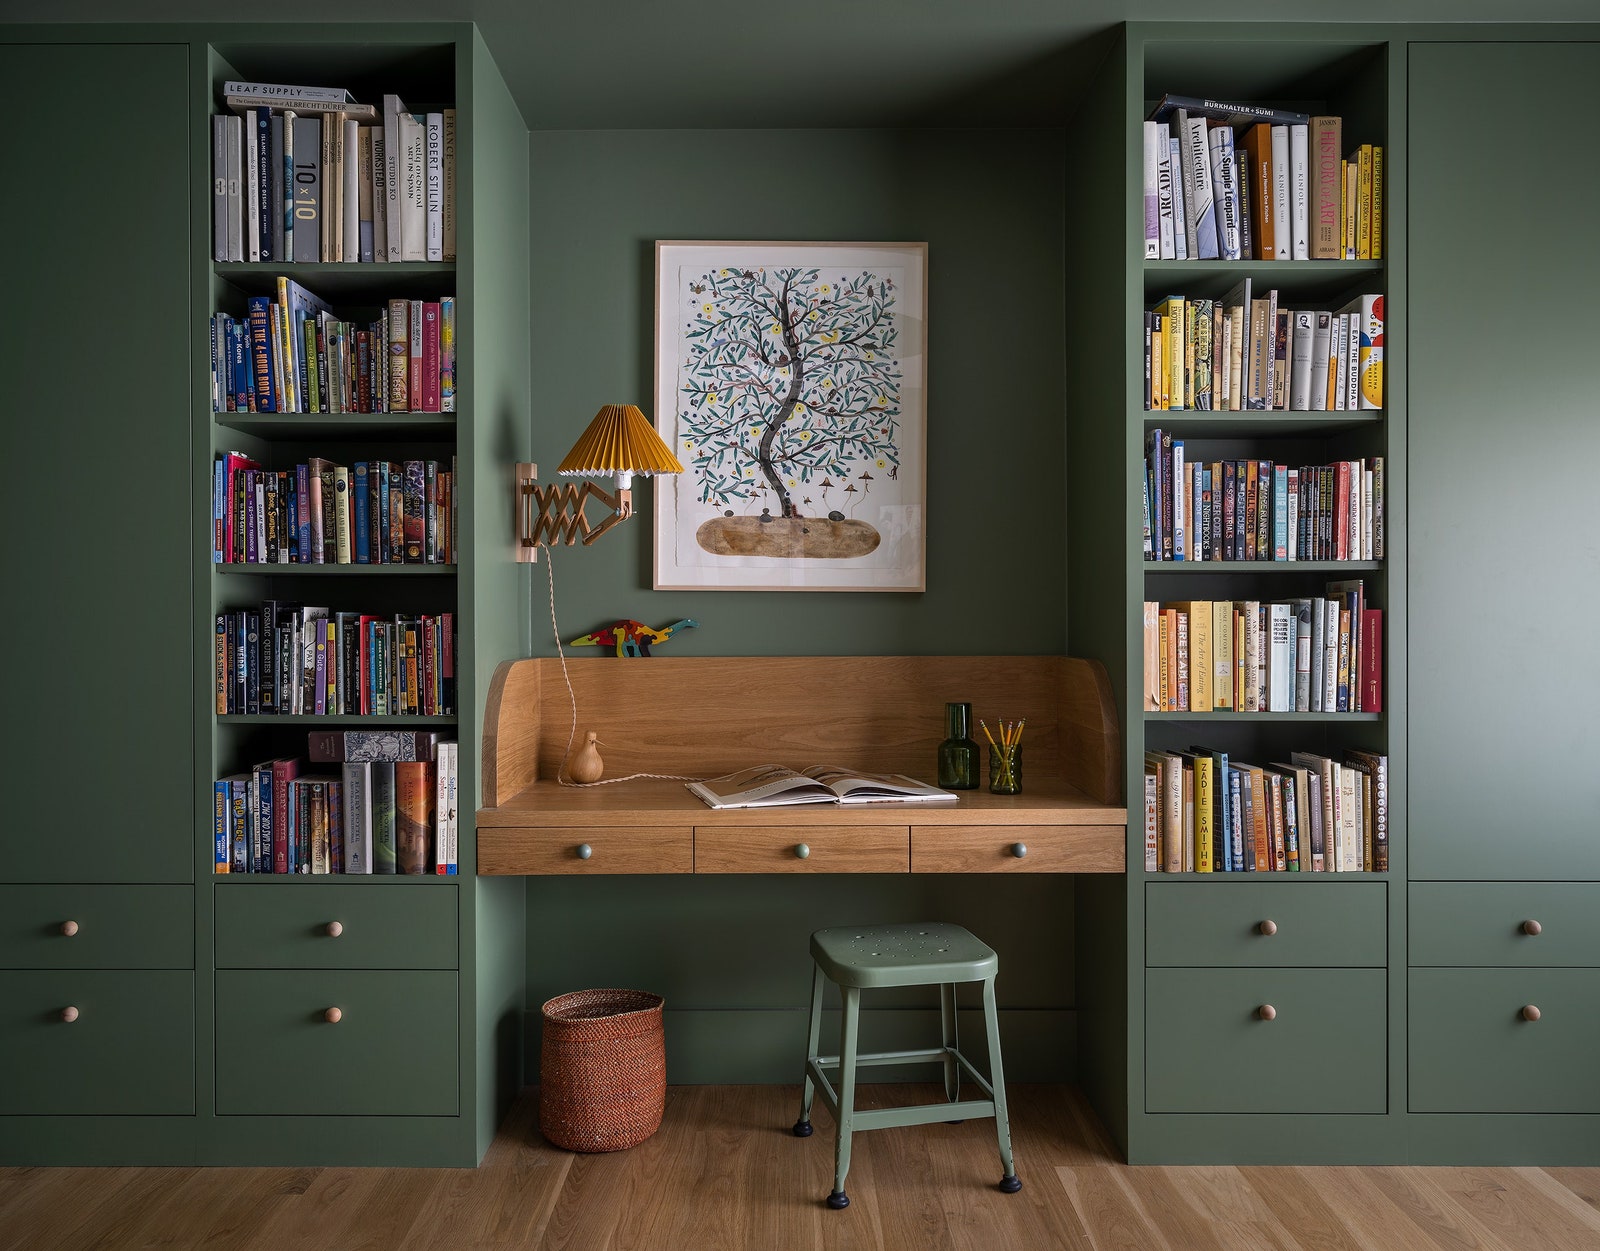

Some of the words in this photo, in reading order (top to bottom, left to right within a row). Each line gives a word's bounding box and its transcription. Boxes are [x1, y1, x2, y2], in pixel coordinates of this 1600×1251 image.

[230, 85, 258, 93] LEAF
[263, 87, 302, 96] SUPPLY
[1204, 101, 1250, 113] BURKHALTER
[1255, 108, 1274, 116] SUMI
[429, 125, 438, 171] ROBERT
[1191, 122, 1205, 191] Architecture
[1320, 131, 1336, 187] HISTORY
[296, 163, 316, 184] 10
[375, 140, 384, 187] WORKSTEAD
[1221, 157, 1232, 189] Supple
[389, 188, 396, 201] KO
[429, 175, 438, 213] STILIN
[1159, 160, 1172, 219] ARCADIA
[1321, 187, 1331, 198] OF
[296, 198, 316, 220] 10
[1224, 191, 1235, 228] Leopard
[1320, 200, 1336, 226] ART
[391, 302, 404, 339] Eugenides
[254, 328, 266, 343] THE
[256, 345, 269, 374] 4-HOUR
[258, 376, 270, 396] BODY
[325, 500, 333, 537] FABLEHAVEN
[263, 607, 271, 637] COSMIC
[1179, 616, 1187, 647] HERE
[237, 646, 245, 669] WEIRD
[263, 639, 271, 673] QUERIES
[1197, 661, 1206, 670] of
[237, 671, 245, 683] KID
[1179, 661, 1187, 679] AM
[1197, 671, 1206, 694] Eating
[1253, 774, 1262, 797] MERCURY
[234, 799, 244, 815] BAD
[262, 801, 271, 815] PACT
[235, 818, 244, 842] MAGIC
[262, 816, 271, 830] OUR
[1147, 805, 1156, 848] broom
[1246, 808, 1254, 840] CROSSOVER
[262, 830, 271, 841] WAS
[1200, 817, 1208, 859] SMITH
[262, 843, 271, 855] THIS
